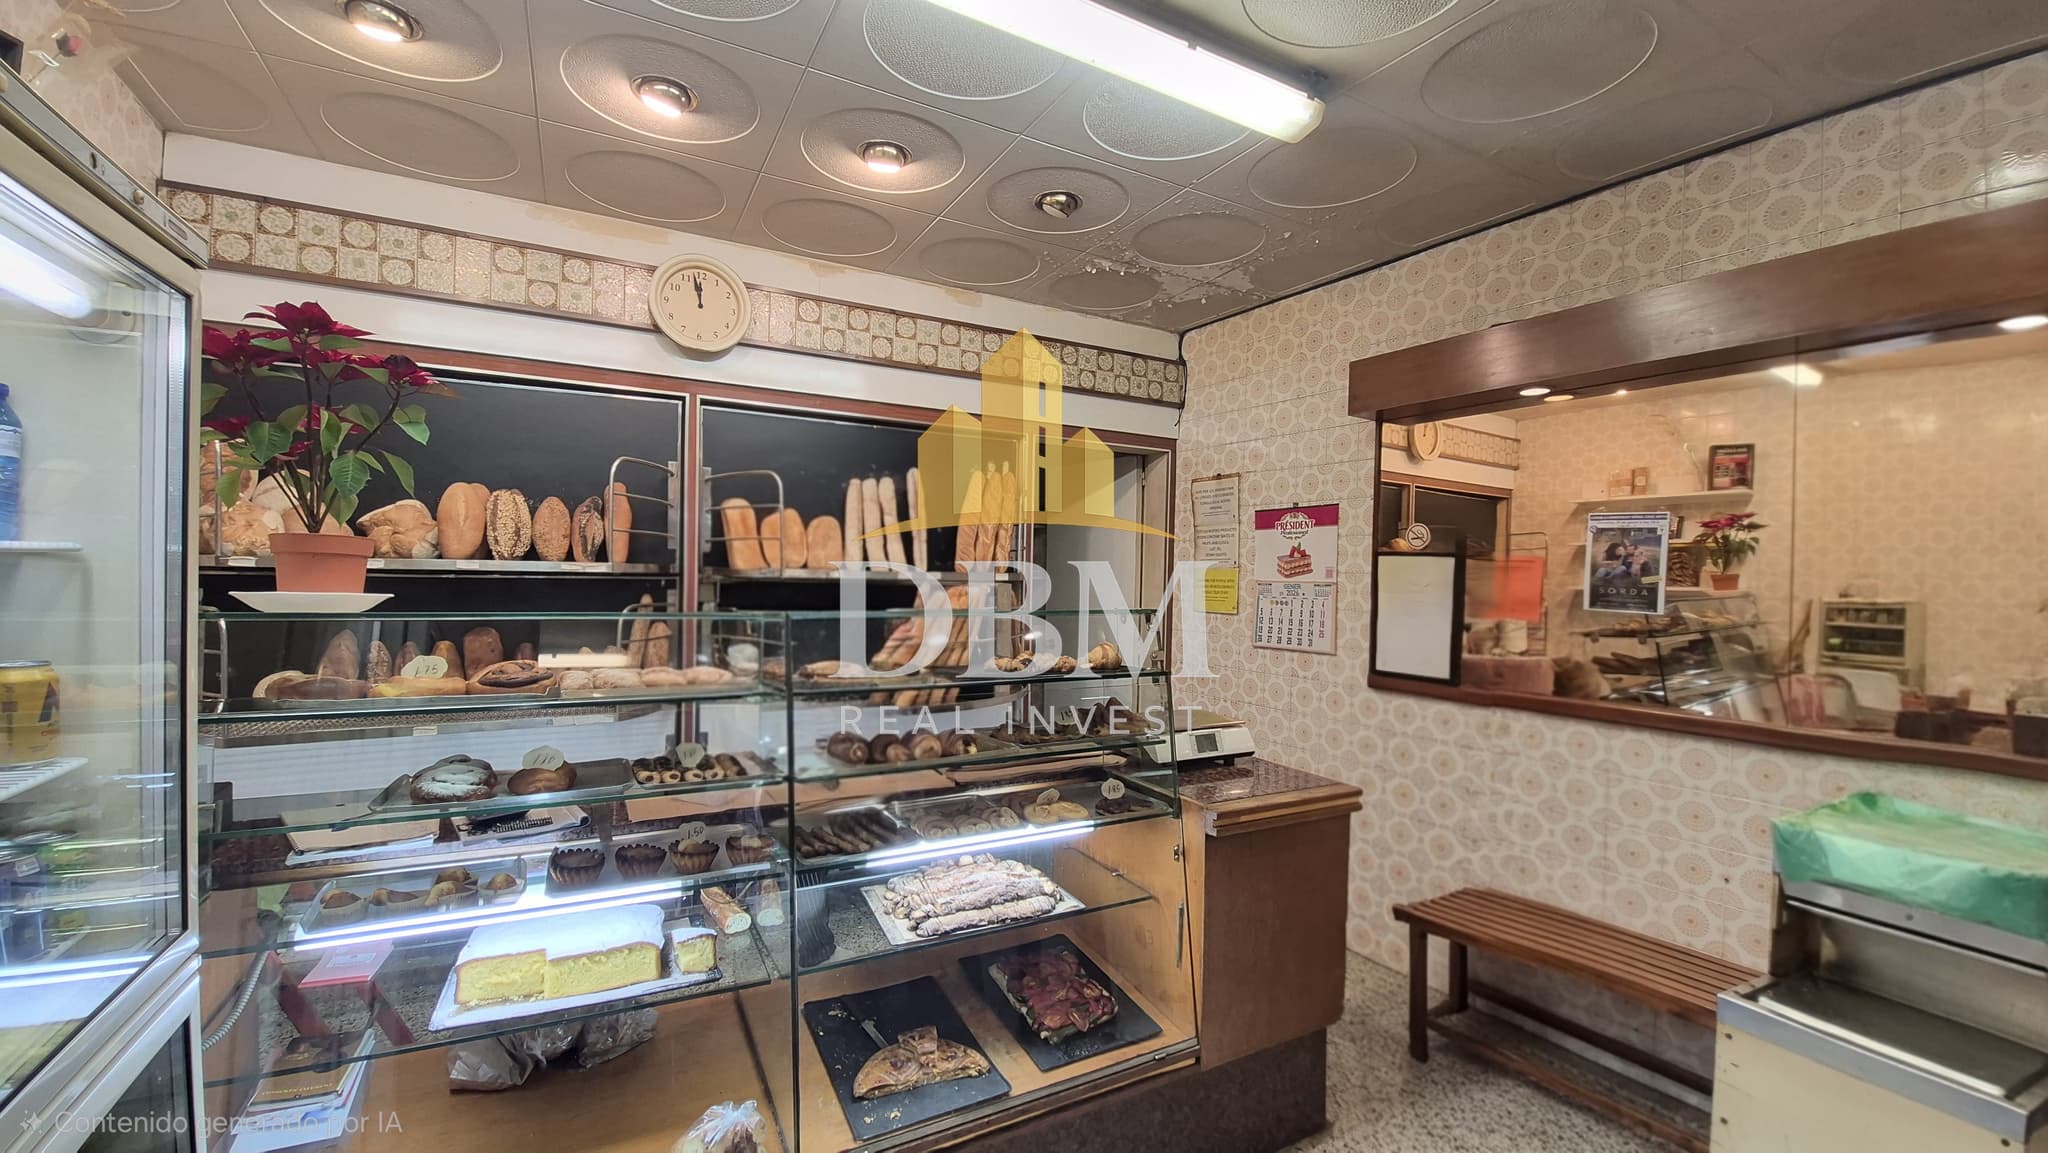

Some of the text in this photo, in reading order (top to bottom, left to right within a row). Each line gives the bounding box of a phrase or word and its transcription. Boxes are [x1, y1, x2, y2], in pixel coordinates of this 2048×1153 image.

[681, 273, 691, 283] 11
[697, 271, 708, 281] 12
[669, 282, 681, 292] 10
[715, 279, 719, 287] 1
[663, 295, 670, 304] 9
[726, 291, 732, 300] 2
[668, 312, 674, 320] 8
[680, 325, 686, 333] 7
[724, 322, 730, 330] 4
[696, 332, 703, 341] 6
[712, 331, 719, 340] 5
[1276, 519, 1315, 531] PRÉSIDENT
[1599, 587, 1648, 596] SORDA
[687, 826, 705, 840] 1.50
